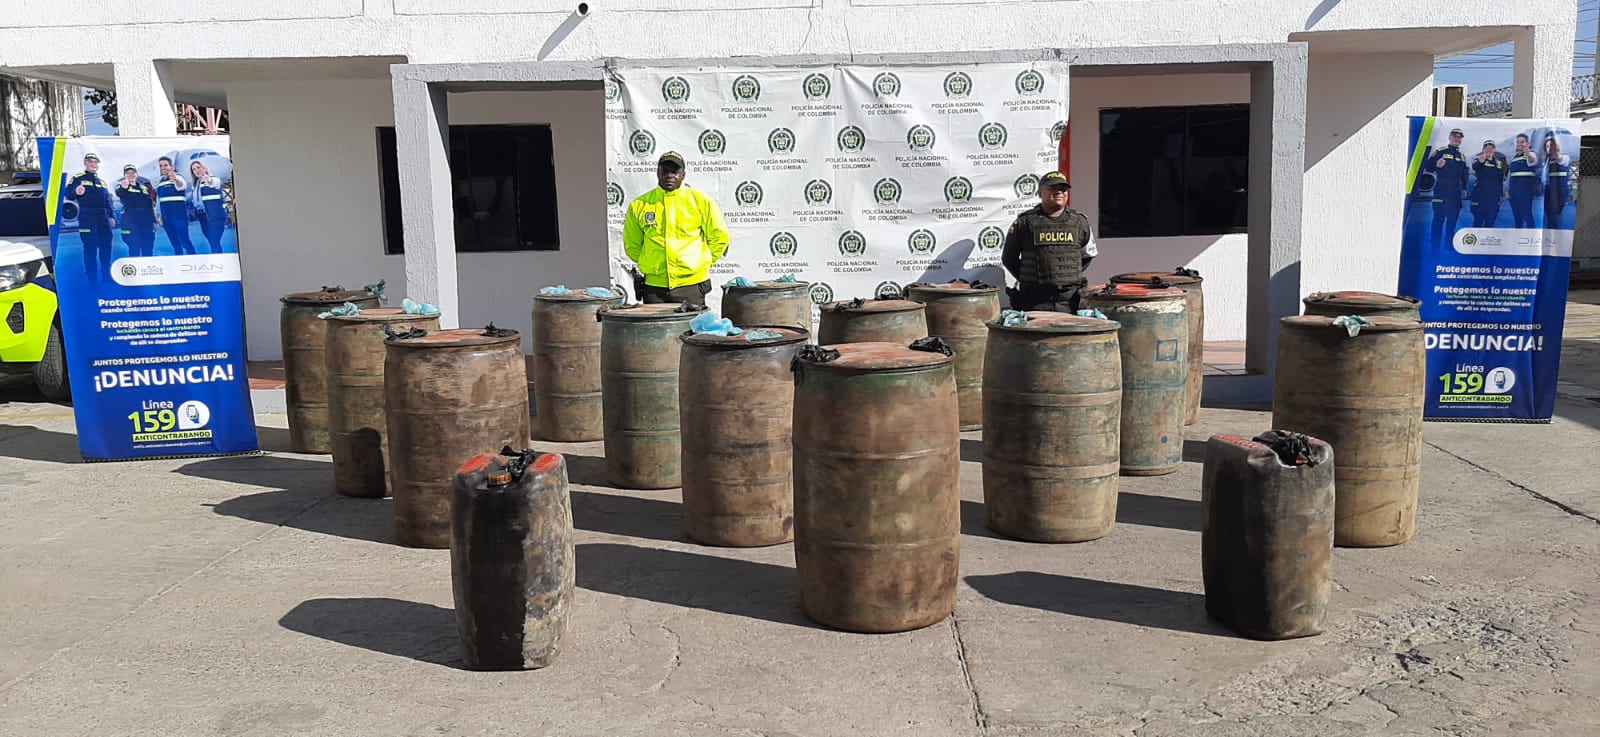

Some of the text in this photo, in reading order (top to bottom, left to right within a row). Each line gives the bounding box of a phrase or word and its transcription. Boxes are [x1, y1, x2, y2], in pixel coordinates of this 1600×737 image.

[1040, 232, 1073, 241] POLICIA
[181, 264, 224, 272] DIAN
[1436, 265, 1490, 274] Protegemos
[1504, 267, 1540, 275] nuestro
[1434, 286, 1488, 294] Protegemos
[1502, 287, 1536, 295] nuestro
[99, 295, 210, 307] Protegemos lo nuestro
[101, 316, 212, 329] Protegemos lo nuestro
[1424, 334, 1543, 351] DENUNCIA!
[125, 356, 178, 365] PROTEGEMOS
[192, 352, 228, 360] NUESTRO
[1456, 363, 1484, 373] Línea
[94, 364, 234, 392] ¡DENUNCIA!
[1440, 373, 1483, 393] 159
[142, 400, 174, 410] Línea
[128, 409, 176, 433] 159
[134, 431, 211, 441] ANTICONTRABANDO
